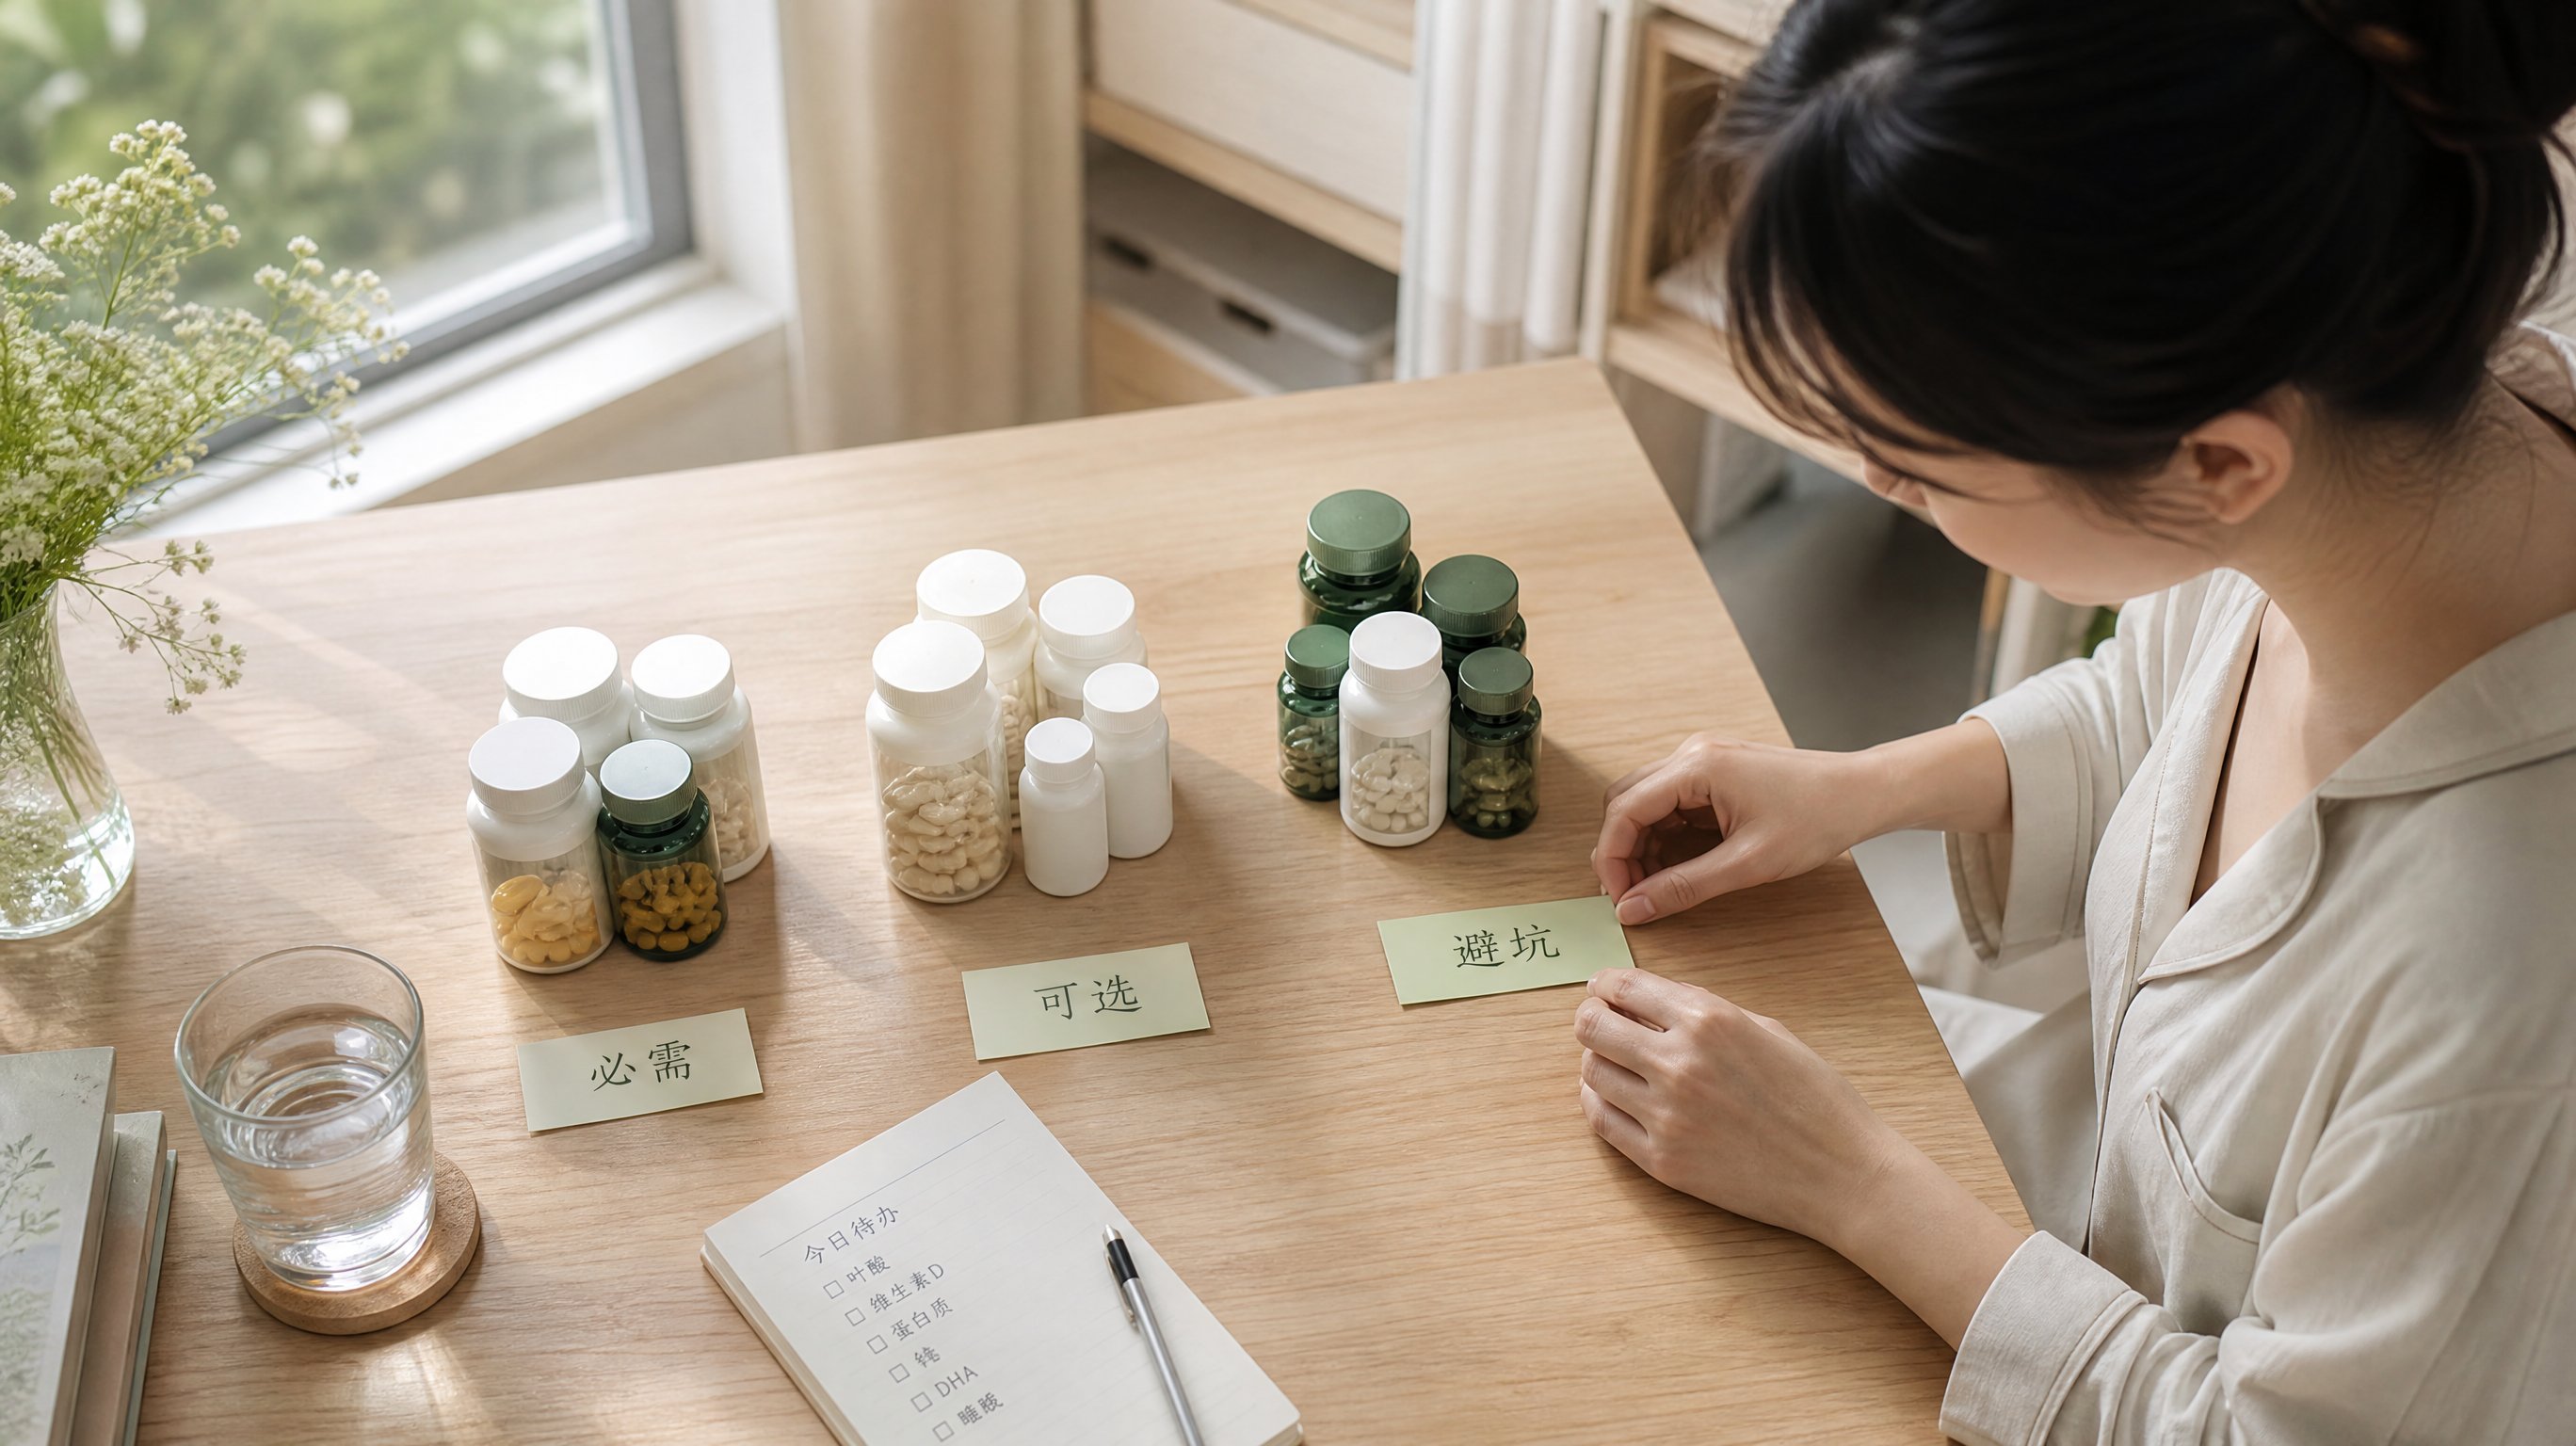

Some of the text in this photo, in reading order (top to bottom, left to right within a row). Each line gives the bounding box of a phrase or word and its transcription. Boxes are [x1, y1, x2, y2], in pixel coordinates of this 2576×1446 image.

[1453, 924, 1561, 969] 避坑
[1033, 974, 1143, 1020] 可选
[590, 1039, 691, 1092] 必需
[803, 1206, 899, 1264] 今日待办
[845, 1255, 892, 1283] 叶酸
[890, 1296, 954, 1342] 蛋白质
[934, 1365, 979, 1398] DHA
